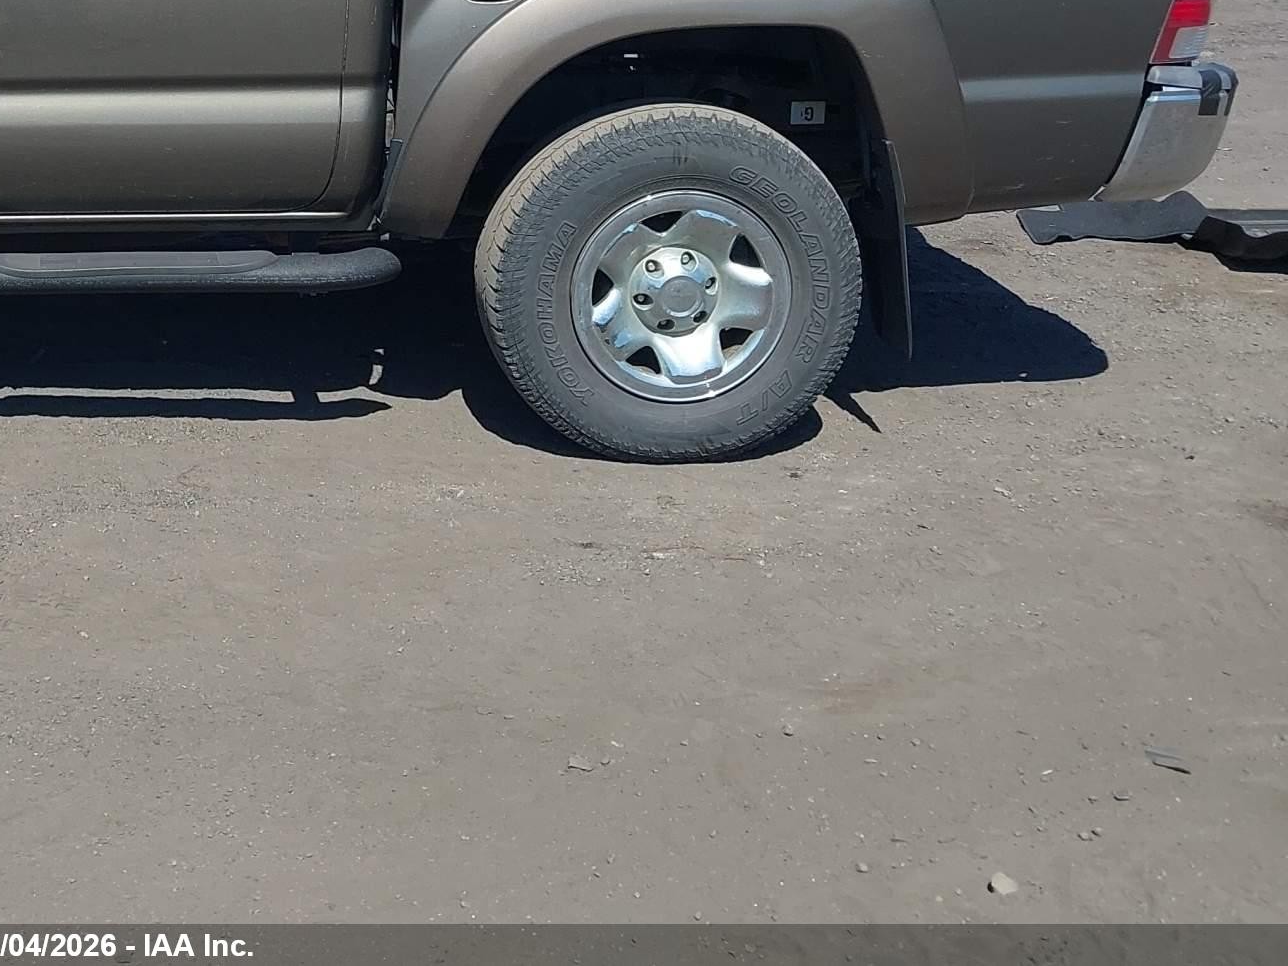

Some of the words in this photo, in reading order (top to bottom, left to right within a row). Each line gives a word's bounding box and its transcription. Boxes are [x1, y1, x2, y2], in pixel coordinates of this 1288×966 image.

[537, 220, 595, 406] YOKOHAMA
[729, 165, 831, 364] GEOLANDAR
[735, 369, 793, 426] A/T
